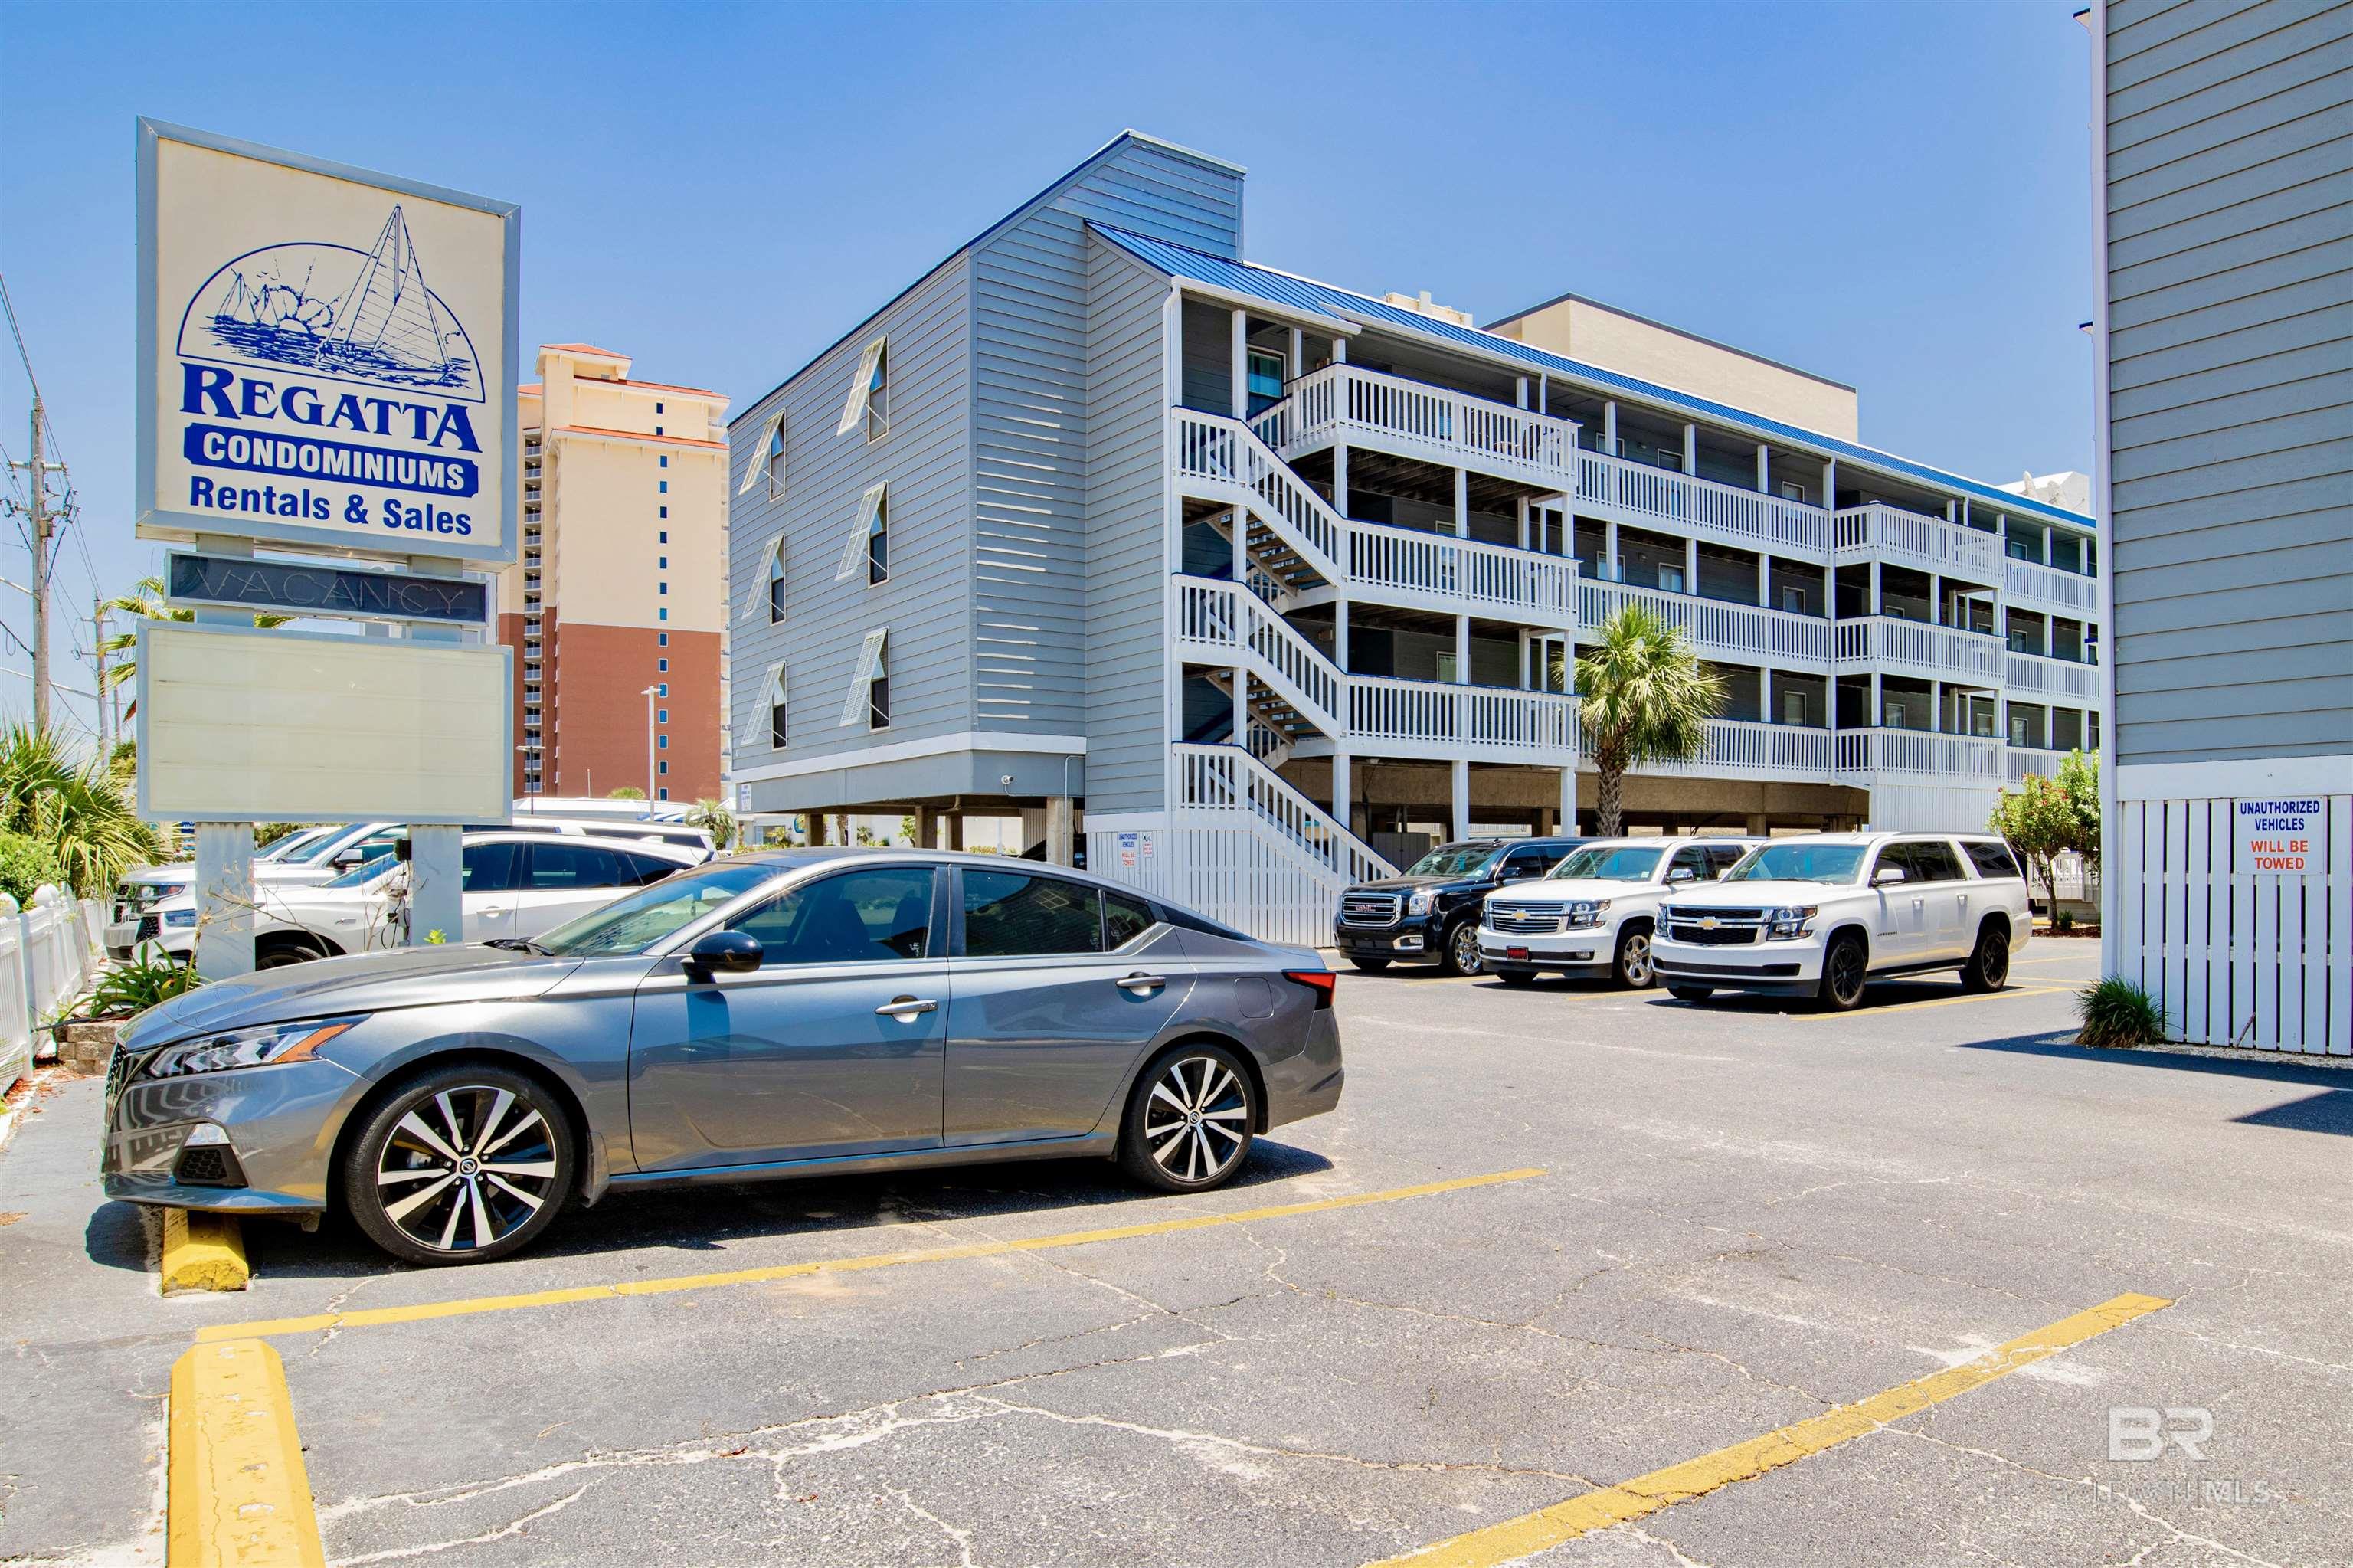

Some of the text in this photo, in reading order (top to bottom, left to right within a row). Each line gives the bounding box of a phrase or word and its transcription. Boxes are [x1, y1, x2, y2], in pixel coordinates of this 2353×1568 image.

[180, 362, 483, 453] REGATTA
[203, 431, 465, 491] CONDOMINIUMS
[190, 476, 472, 535] Rentals & Sales
[196, 567, 463, 614] VACANCY
[2240, 800, 2320, 815] UNAUTHORIZED
[2255, 817, 2305, 831] VEHICLES
[2251, 840, 2309, 853] WILL BE
[2254, 857, 2305, 870] TOWED
